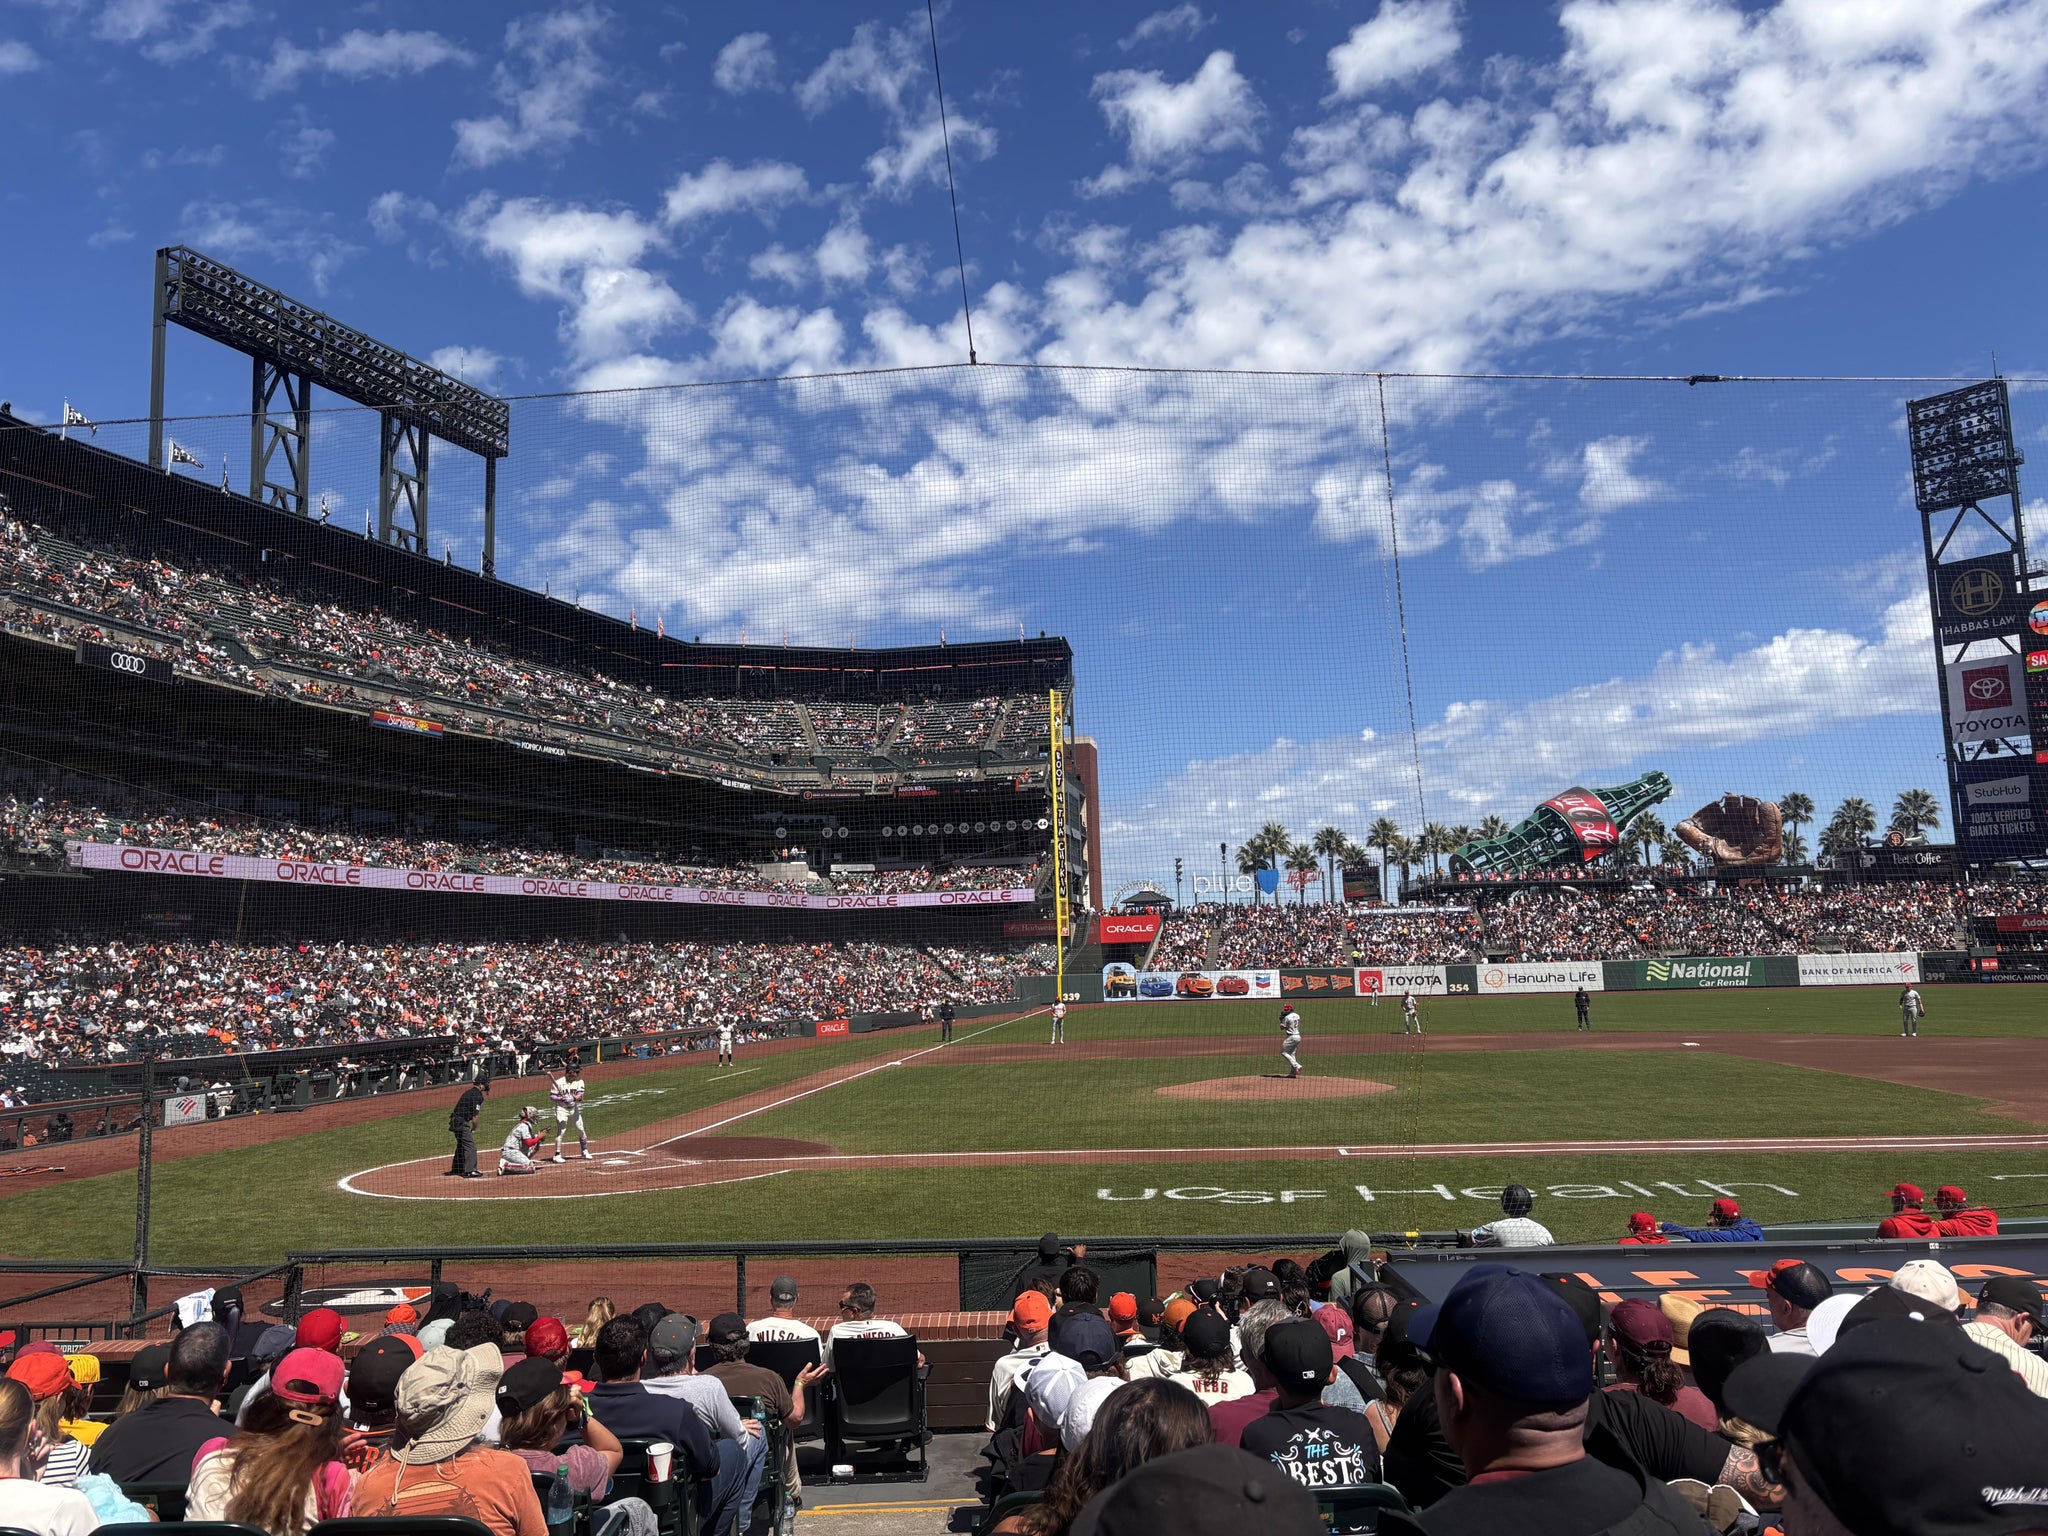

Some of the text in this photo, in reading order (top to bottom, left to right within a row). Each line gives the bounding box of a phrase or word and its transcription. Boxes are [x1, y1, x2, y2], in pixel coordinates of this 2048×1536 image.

[1944, 614, 2016, 635] HABBAS LAW
[1956, 714, 2027, 734] TOYOTA
[521, 741, 567, 756] KONICA MINOLTA
[1974, 785, 2021, 798] StubHub
[1970, 808, 2032, 824] 100% VERIFIED
[1969, 821, 2036, 837] GIANTS TICKETS
[121, 848, 225, 876] ORACLE
[1914, 852, 1942, 865] Coffee
[276, 862, 361, 885] ORACLE
[406, 872, 485, 892] ORACLE
[522, 878, 587, 897] ORACLE
[1193, 871, 1253, 893] blue
[618, 884, 673, 901] ORACLE
[699, 889, 746, 905] ORACLE
[767, 893, 808, 908] ORACLE
[939, 889, 1012, 905] ORACLE
[826, 894, 898, 909] ORACLE
[1106, 924, 1155, 933] ORACLE
[1507, 971, 1597, 984] Hanwha Life
[1671, 961, 1751, 979] National
[1801, 966, 1893, 976] BANK OF AMERICA
[1926, 972, 1946, 981] 399
[1992, 974, 2022, 982] KONICA
[1387, 975, 1443, 987] TOYOTA
[1449, 984, 1470, 992] 354
[1698, 978, 1749, 987] Car Rental
[1062, 993, 1080, 1001] 339
[820, 1023, 845, 1033] ORACLE
[1097, 1179, 1801, 1204] UCSF Health
[1192, 1379, 1229, 1395] WEBB
[1304, 1443, 1330, 1459] THE
